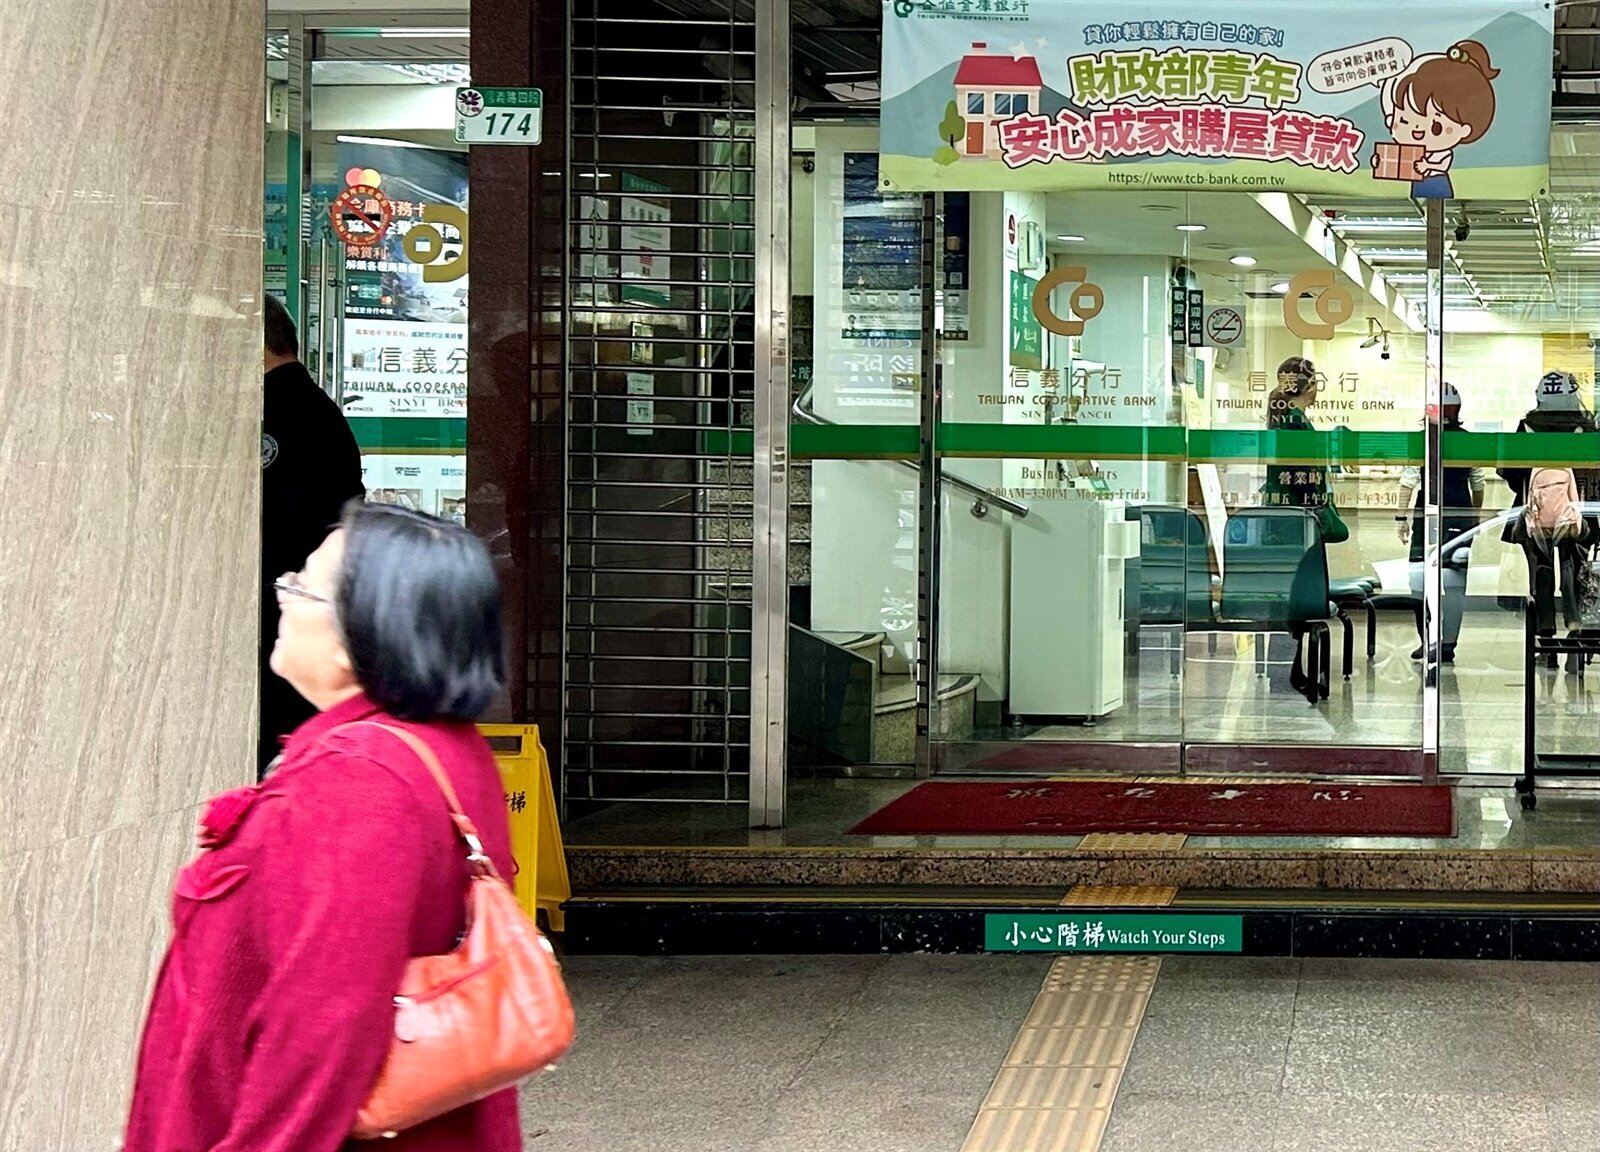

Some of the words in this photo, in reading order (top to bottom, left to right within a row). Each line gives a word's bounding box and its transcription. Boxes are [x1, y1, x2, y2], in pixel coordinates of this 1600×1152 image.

[1083, 20, 1285, 47] 貸你輕鬆擁有自己的家!
[1320, 47, 1395, 73] 符合貸款資格者
[1069, 49, 1300, 105] 財政部青年
[485, 112, 532, 136] 174
[1001, 106, 1362, 170] 安心成家購屋貸款
[1108, 171, 1285, 188] https://www.tcb-bank.com.tw
[1190, 293, 1202, 344] 歡迎光臨
[343, 381, 394, 392] TAIWAN
[1008, 366, 1122, 389] 信義分行
[1246, 371, 1360, 393] 信義分行
[978, 394, 1025, 406] TAIWAN
[1123, 395, 1157, 406] BANK
[1216, 398, 1263, 410] TAIWAN
[1270, 399, 1355, 410] COOERATIVE
[1361, 400, 1395, 410] BANK
[1005, 920, 1105, 948] 小心階梯
[1106, 929, 1149, 944] Watch
[1151, 930, 1185, 945] Your
[1187, 929, 1226, 948] Steps
